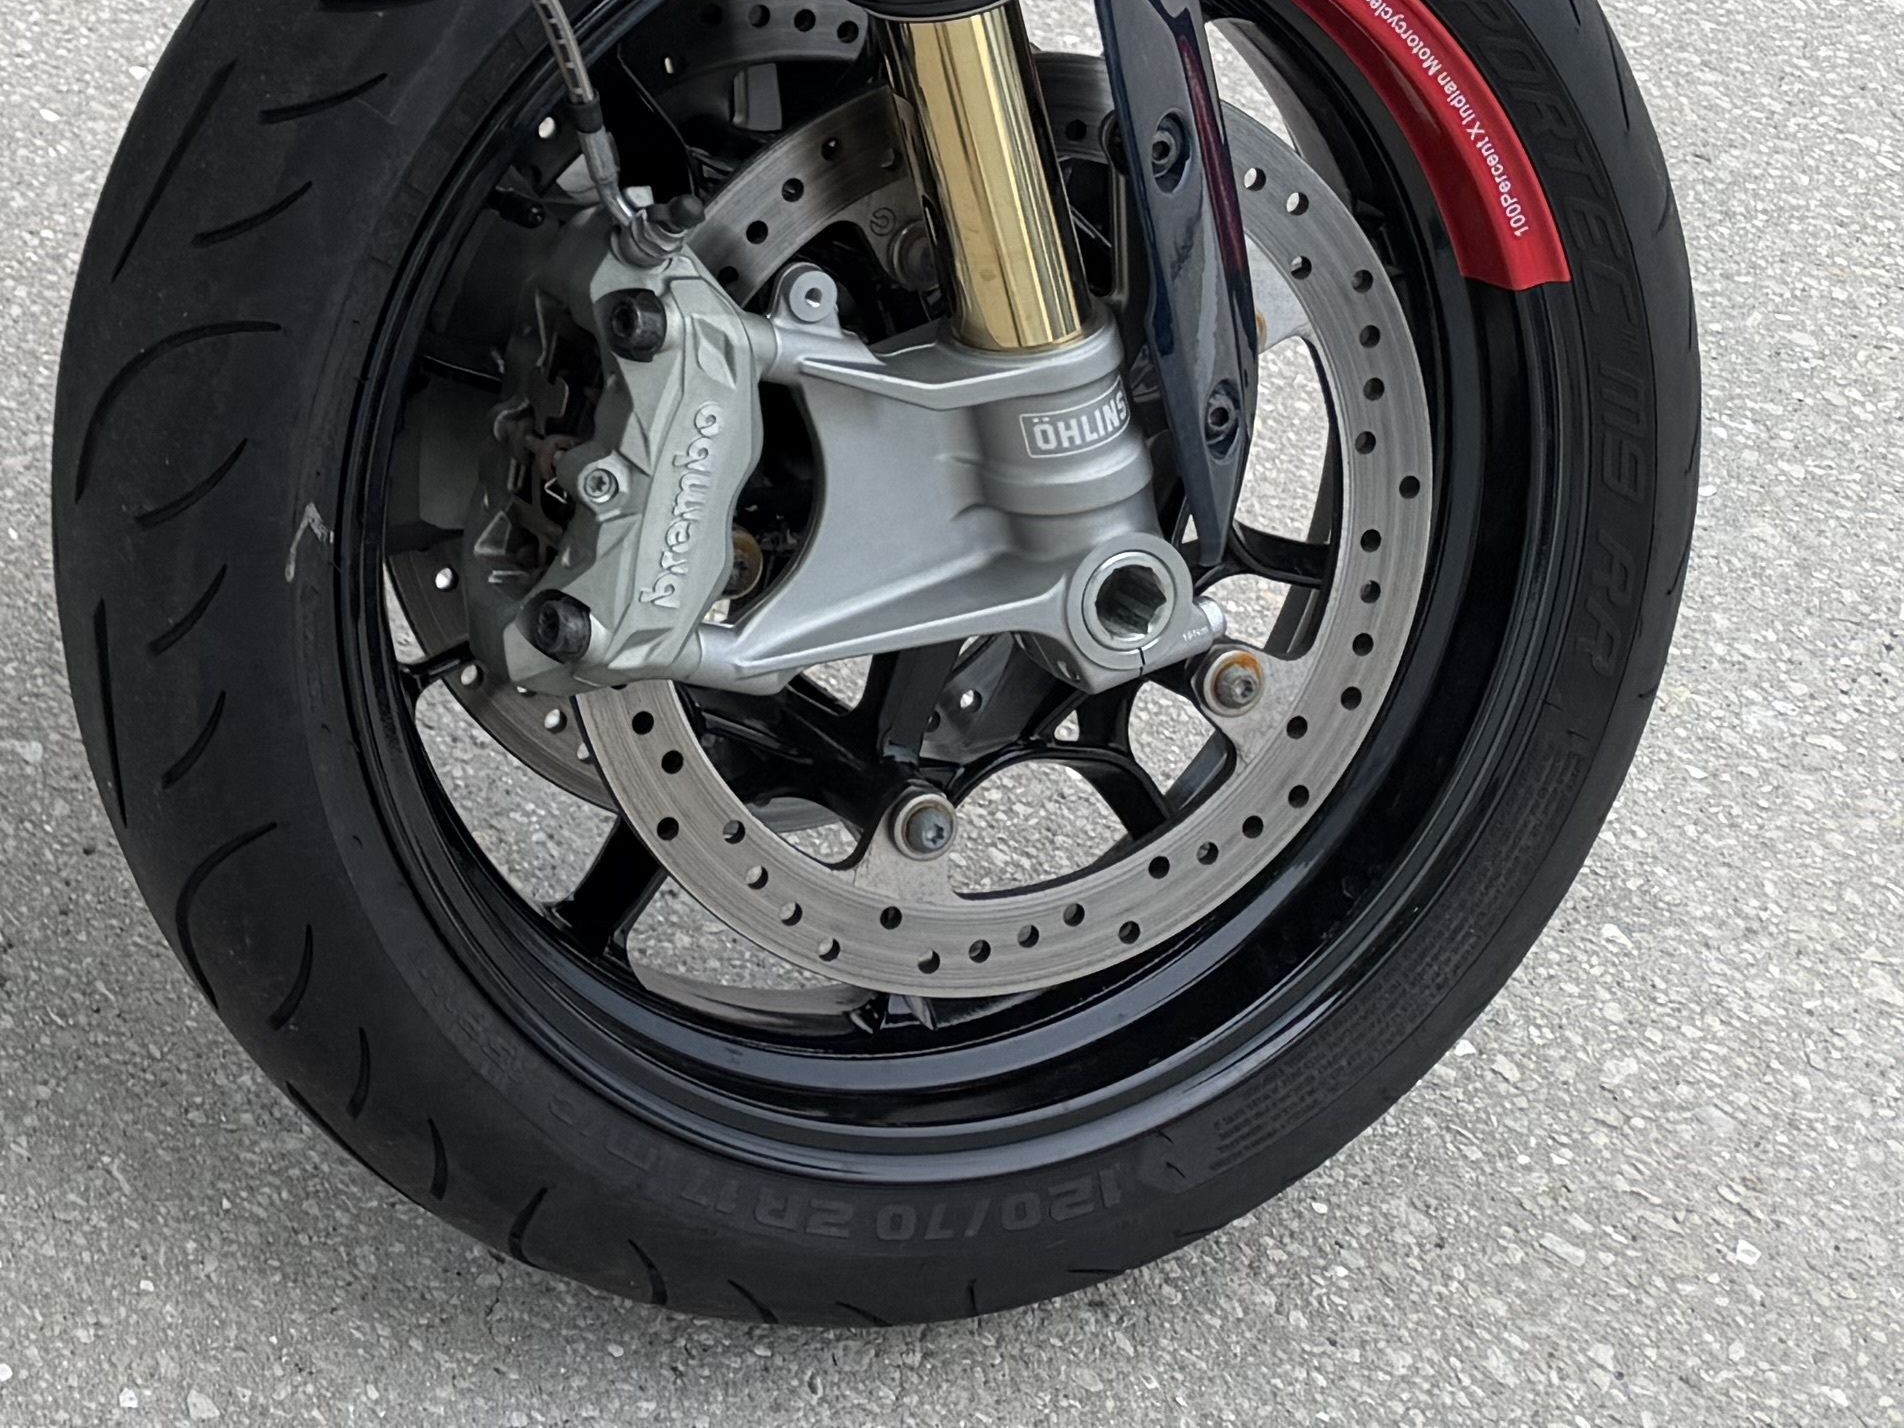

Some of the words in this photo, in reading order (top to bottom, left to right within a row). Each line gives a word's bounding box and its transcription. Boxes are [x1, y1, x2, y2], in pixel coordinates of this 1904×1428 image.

[1436, 70, 1476, 126] Indian
[1466, 120, 1486, 141] X
[1474, 135, 1530, 238] 100Percent
[1032, 390, 1128, 452] ÖHLINS
[639, 400, 726, 610] brembo
[676, 1164, 738, 1216] 17
[751, 1184, 856, 1242] ZR
[875, 1162, 1122, 1243] 120/70
